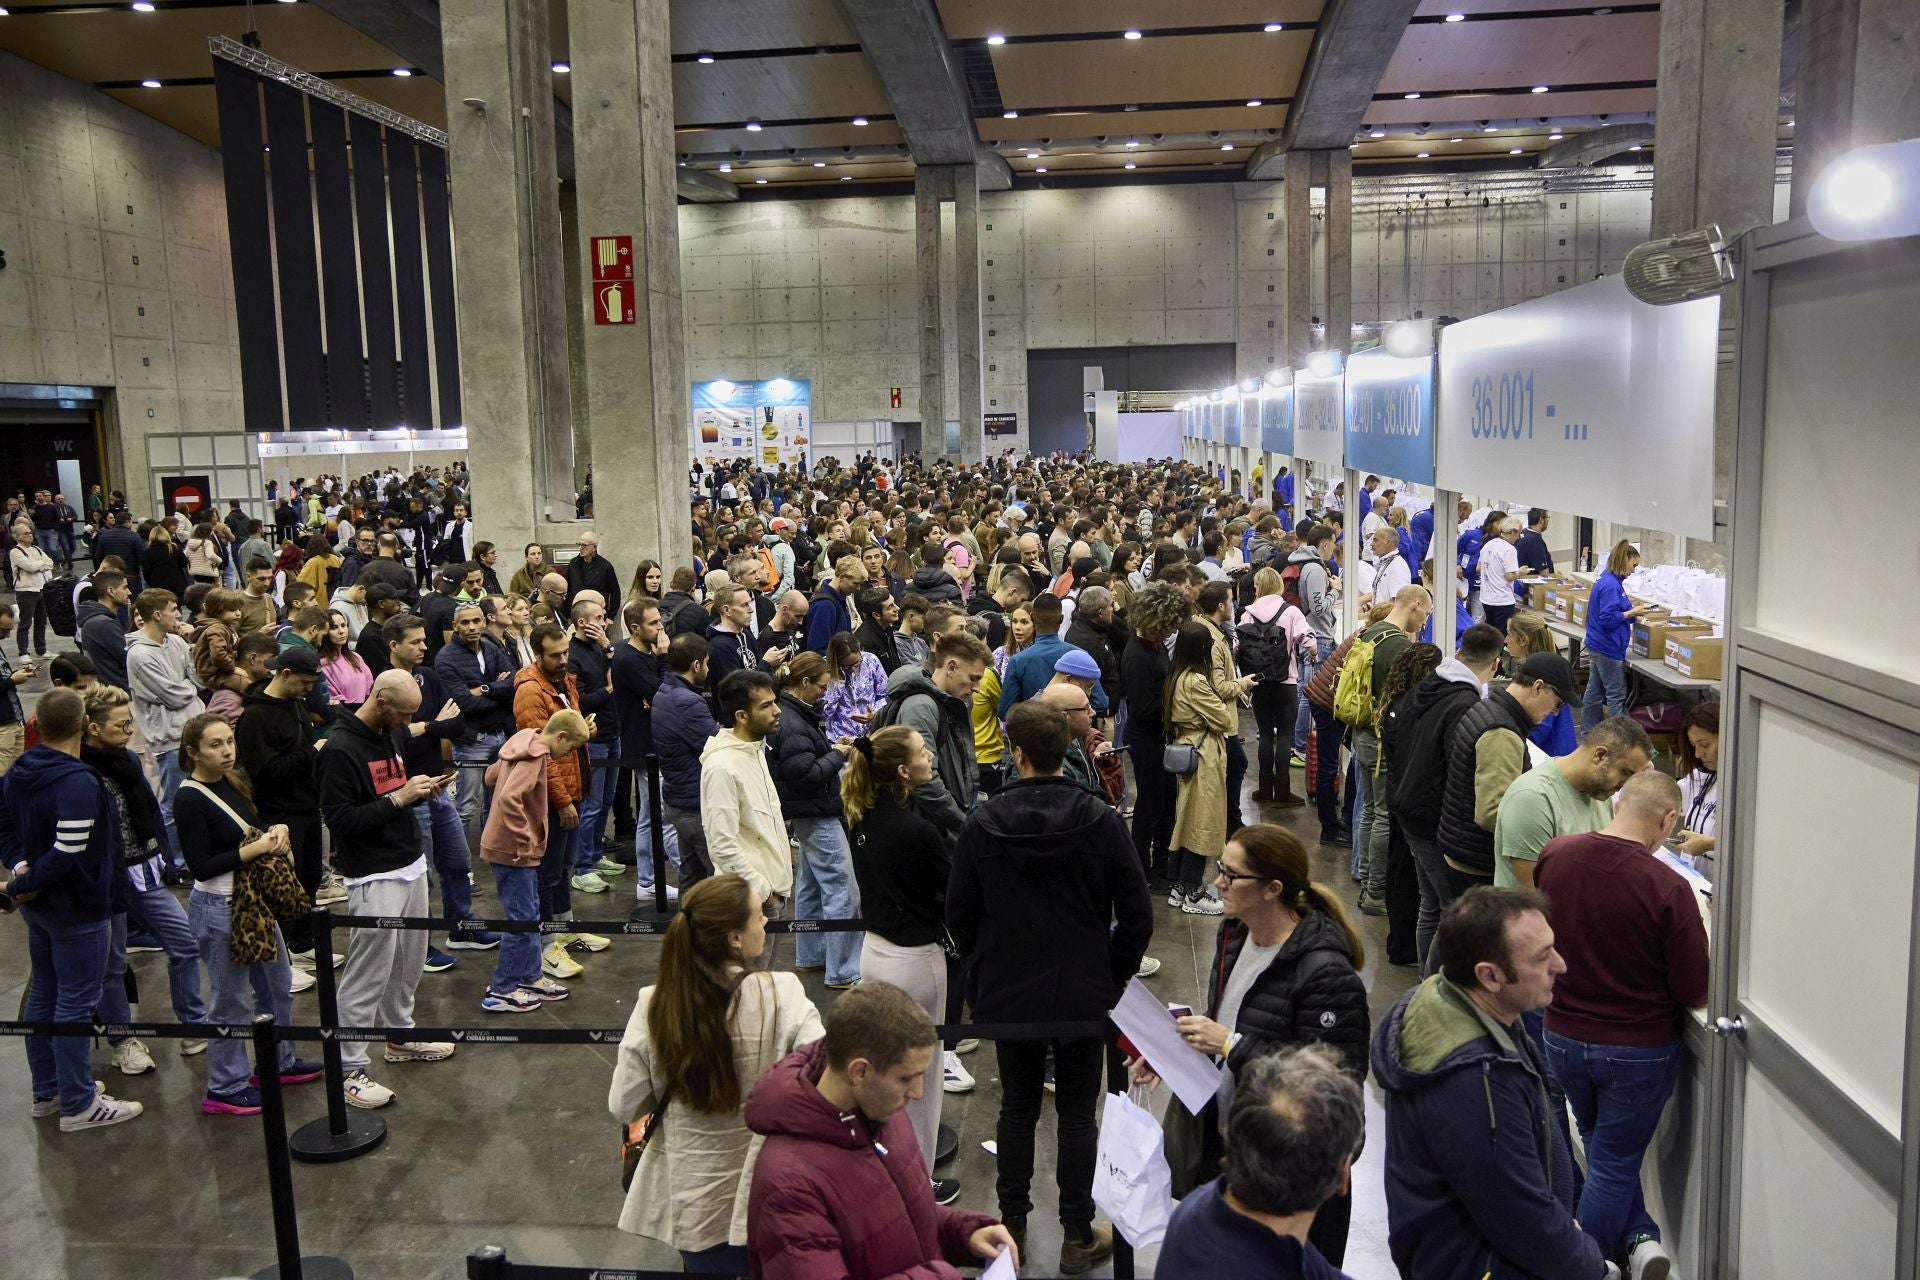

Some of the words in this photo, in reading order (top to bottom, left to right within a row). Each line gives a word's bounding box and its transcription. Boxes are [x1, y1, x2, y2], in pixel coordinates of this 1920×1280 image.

[1350, 391, 1374, 433] 32.401
[1384, 384, 1420, 436] 36.000
[1472, 370, 1534, 440] 36.001
[54, 440, 73, 452] WC
